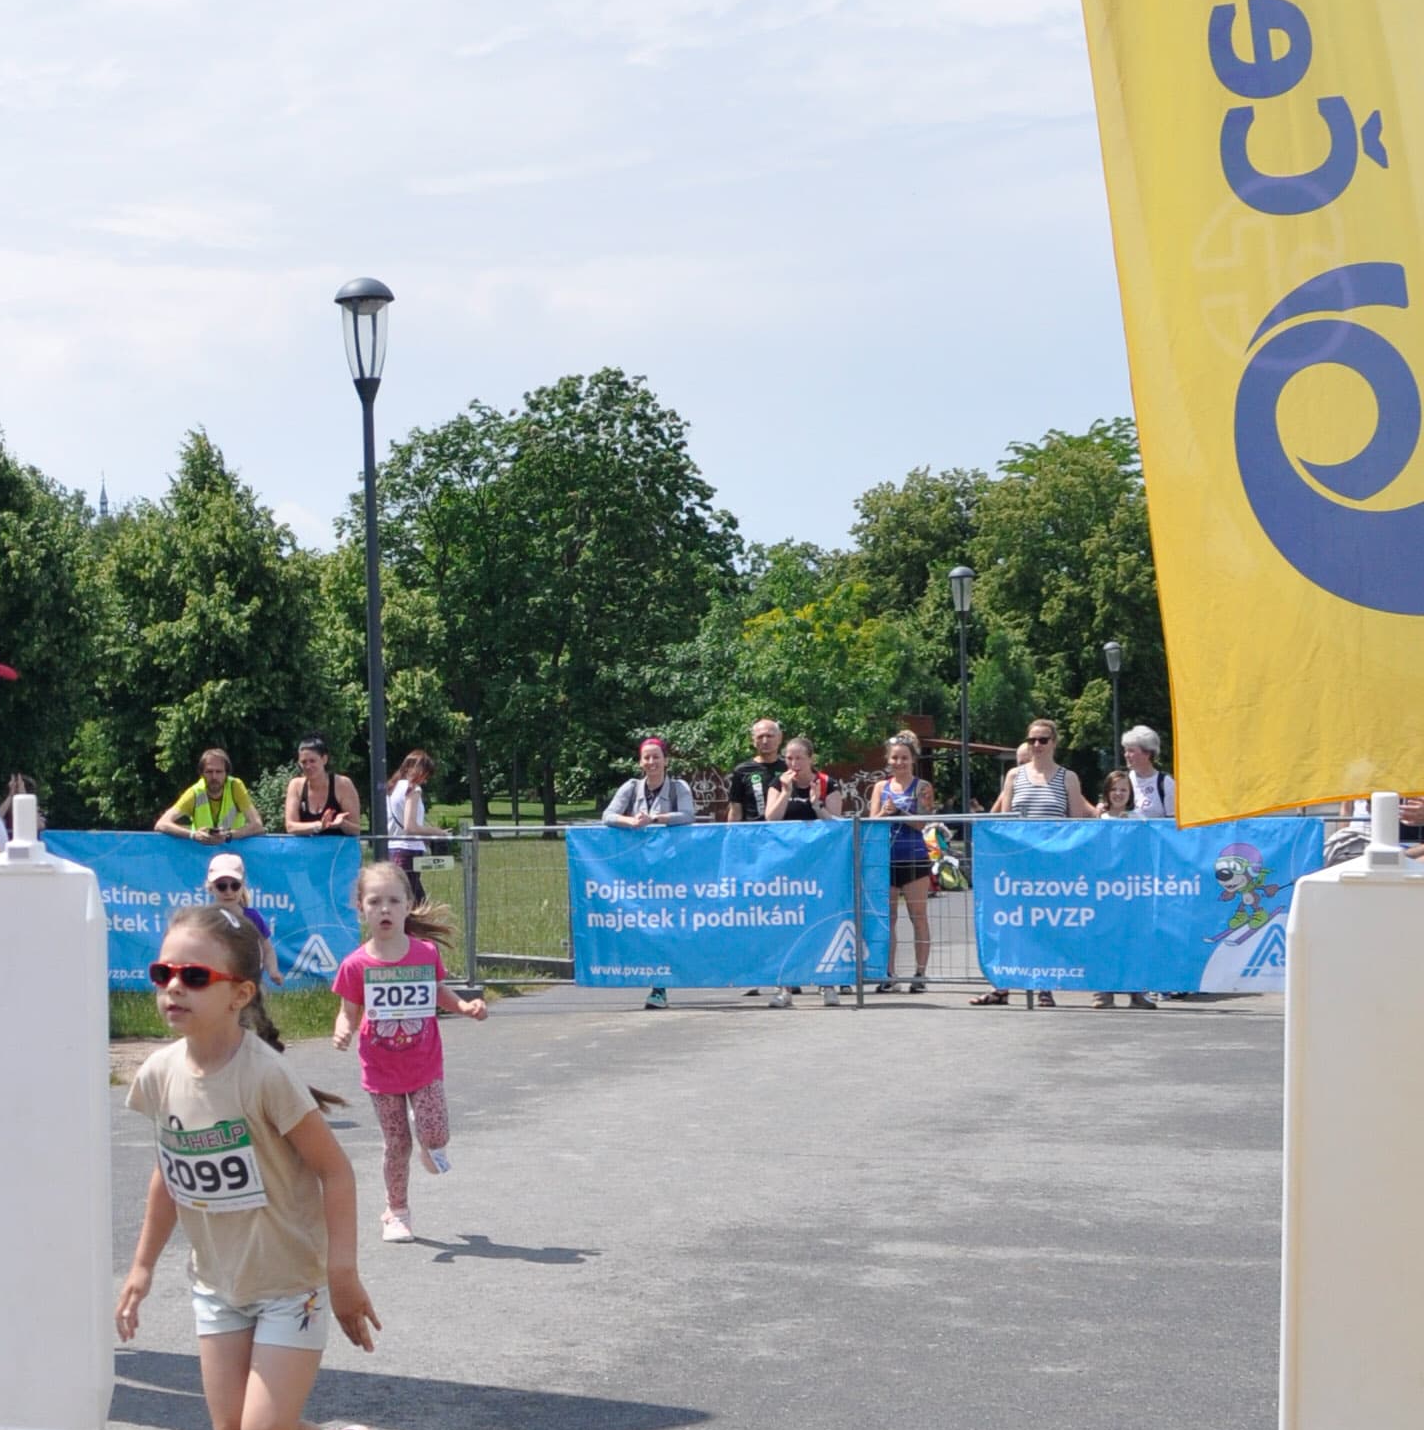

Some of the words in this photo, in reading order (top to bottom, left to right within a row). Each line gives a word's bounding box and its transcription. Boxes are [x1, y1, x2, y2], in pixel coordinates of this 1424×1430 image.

[102, 885, 161, 906] stíme
[585, 878, 688, 904] Pojistíme
[694, 877, 737, 899] vaši
[743, 875, 824, 899] rodinu,
[993, 871, 1089, 897] Úrazové
[1096, 874, 1201, 901] pojištění
[105, 913, 149, 932] etek
[587, 908, 674, 932] majetek
[681, 908, 687, 929] i
[693, 905, 805, 931] podnikání
[993, 906, 1023, 926] od
[1031, 907, 1095, 927] PVZP
[590, 964, 672, 977] www.pvzp.cz
[993, 964, 1084, 979] www.pvzp.cz
[372, 985, 429, 1007] 2023
[161, 1151, 249, 1193] 2099
